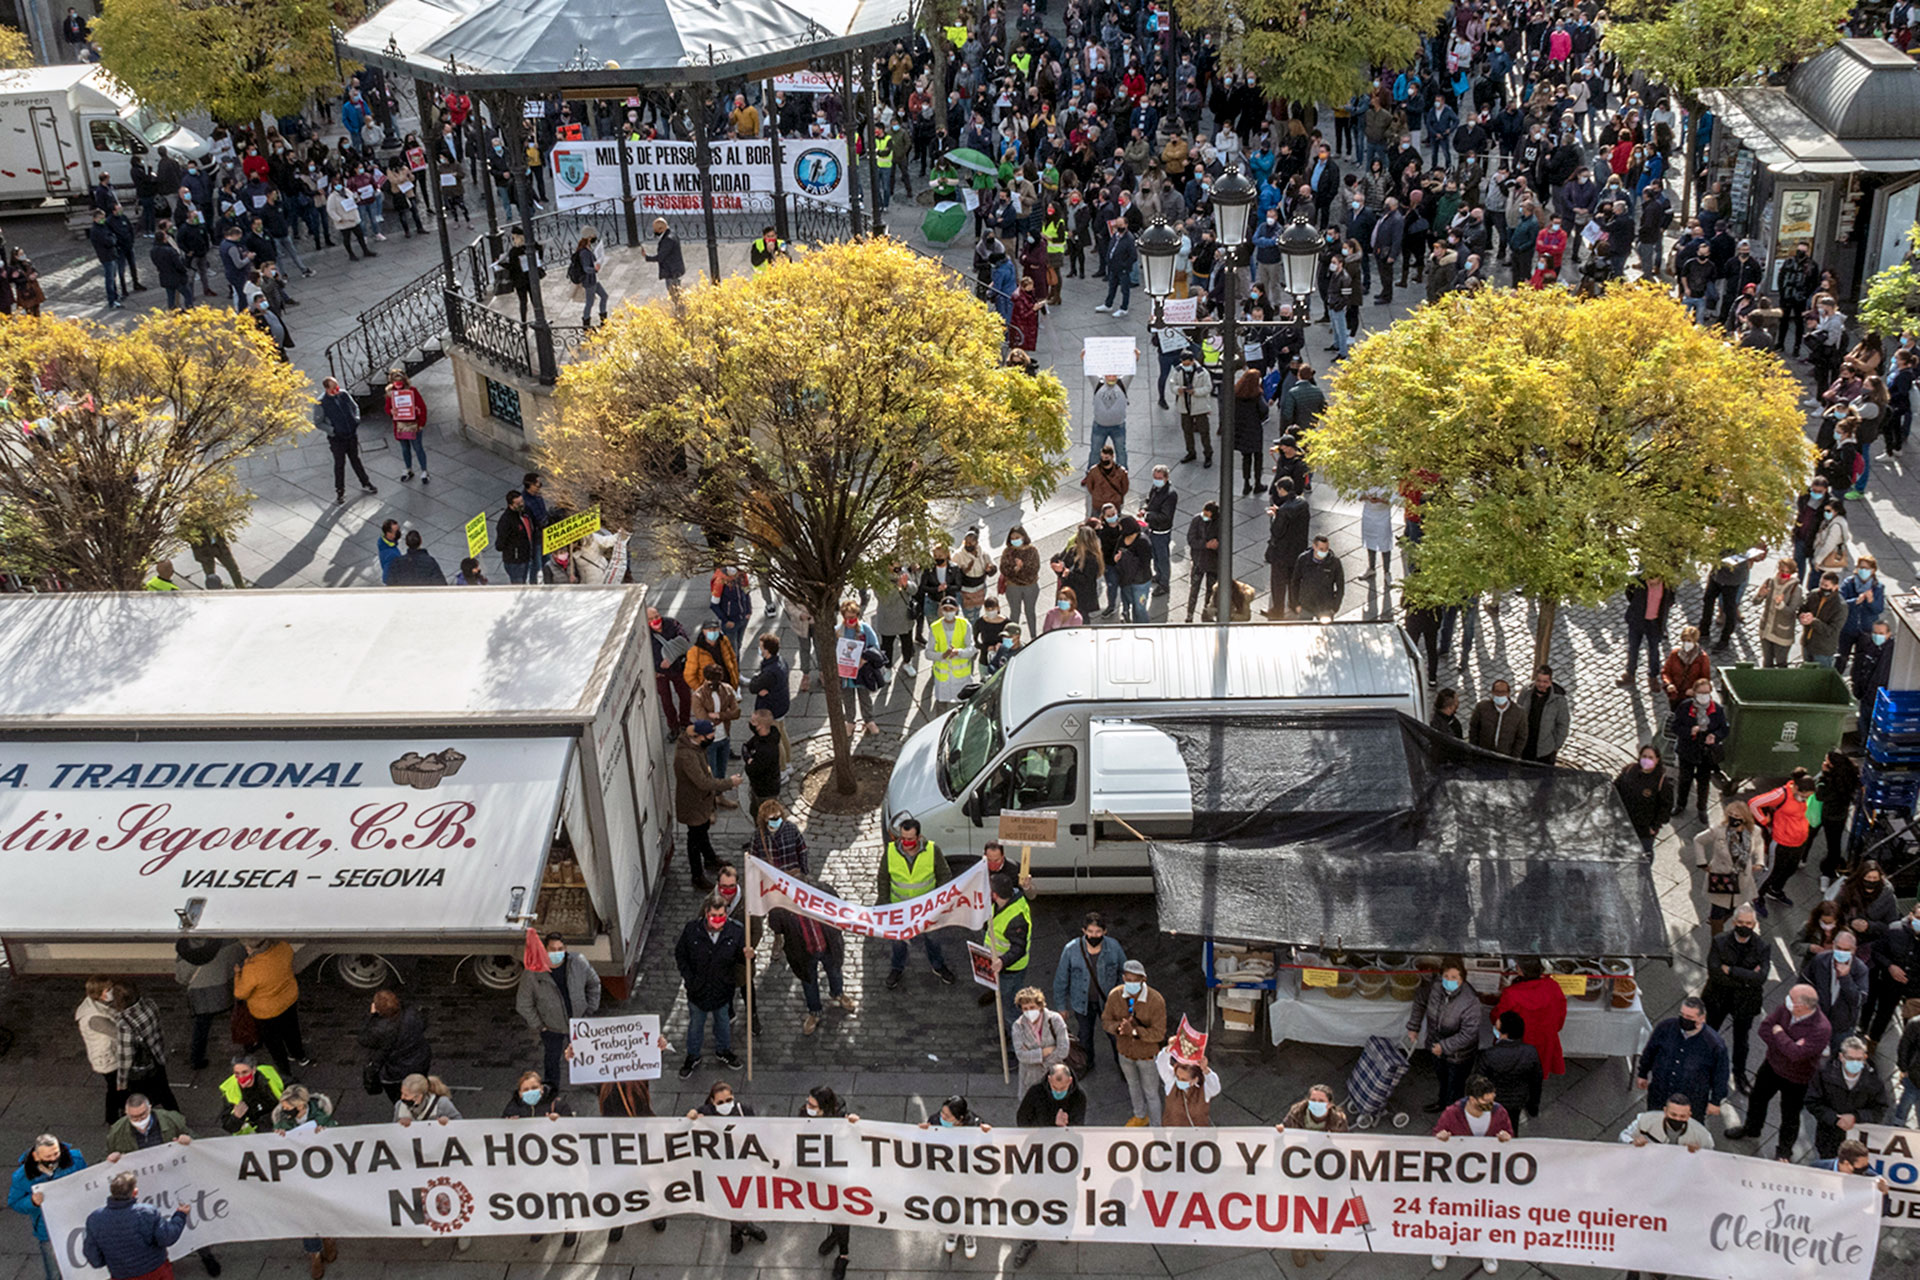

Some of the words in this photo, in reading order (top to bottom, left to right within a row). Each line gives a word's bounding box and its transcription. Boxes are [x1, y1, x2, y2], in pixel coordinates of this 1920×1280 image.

[595, 147, 633, 165] MILS
[636, 146, 653, 165] DE
[656, 146, 721, 165] PERSOS
[727, 146, 742, 165] AL
[746, 145, 787, 165] BORE
[635, 173, 651, 191] DE
[654, 173, 669, 191] LA
[673, 173, 750, 192] MENICIDAD
[547, 506, 599, 534] QUEREMO
[548, 514, 597, 541] TRABAJAR
[0, 764, 29, 788] A
[49, 762, 364, 788] TRADICIONAL
[0, 810, 91, 851] tin
[96, 803, 333, 876] Segovia,
[350, 800, 477, 850] C.B.
[181, 869, 299, 888] VALSECA
[328, 868, 446, 888] SEGOVIA
[793, 887, 904, 925] RESCATE
[910, 884, 962, 921] PARA
[572, 1021, 643, 1040] ¡Queremos
[591, 1032, 650, 1051] Trabajar!
[573, 1051, 595, 1067] No
[601, 1050, 638, 1063] somos
[599, 1064, 610, 1075] el
[238, 1139, 402, 1182] APOYA
[412, 1136, 474, 1169] LA
[483, 1124, 780, 1170] HOSTELERÍA,
[796, 1133, 849, 1168] EL
[861, 1135, 1091, 1181] TURISMO,
[1107, 1140, 1222, 1174] OCIO
[1236, 1141, 1268, 1176] Y
[1280, 1145, 1538, 1186] COMERCIO
[1859, 1130, 1913, 1159] LA
[84, 1182, 99, 1191] EL
[172, 1155, 188, 1167] DE
[388, 1182, 468, 1230] NO
[488, 1189, 651, 1221] somos
[664, 1170, 705, 1203] el
[717, 1175, 888, 1225] VIRUS,
[904, 1195, 1069, 1226] somos
[1086, 1189, 1127, 1227] la
[1142, 1189, 1367, 1235] VACUNA
[1741, 1178, 1754, 1188] EL
[1761, 1181, 1814, 1197] SECRETO
[1821, 1190, 1836, 1201] DE
[1392, 1197, 1422, 1215] 24
[1428, 1197, 1521, 1220] familias
[1528, 1206, 1571, 1226] que
[1577, 1207, 1668, 1233] quieren
[1760, 1198, 1813, 1235] San
[1392, 1220, 1482, 1246] trabajar
[1489, 1228, 1516, 1244] en
[1523, 1229, 1616, 1252] paz!!!!!!!
[1709, 1212, 1864, 1266] Clemente
